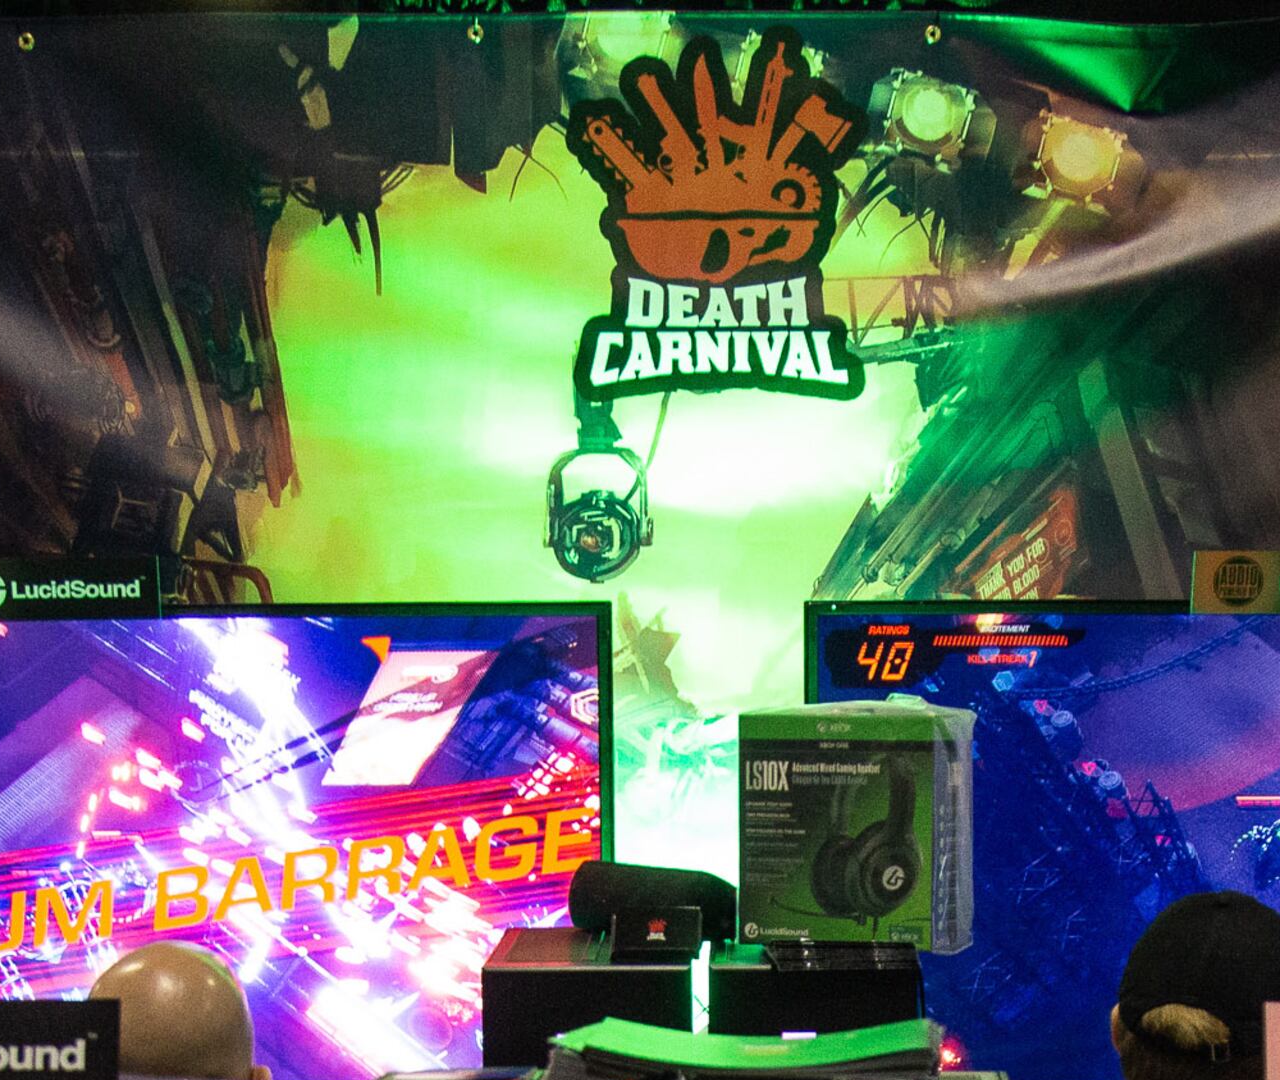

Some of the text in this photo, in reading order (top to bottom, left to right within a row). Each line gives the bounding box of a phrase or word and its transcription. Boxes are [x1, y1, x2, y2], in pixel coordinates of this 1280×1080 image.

[625, 276, 810, 328] DEATH
[589, 330, 850, 387] CARNIVAL
[11, 580, 141, 600] LucidSound
[868, 625, 910, 636] RATINGS
[857, 641, 915, 681] 40
[745, 760, 790, 792] LS10X
[153, 806, 596, 930] BARRAGE
[759, 927, 809, 938] LucidSound
